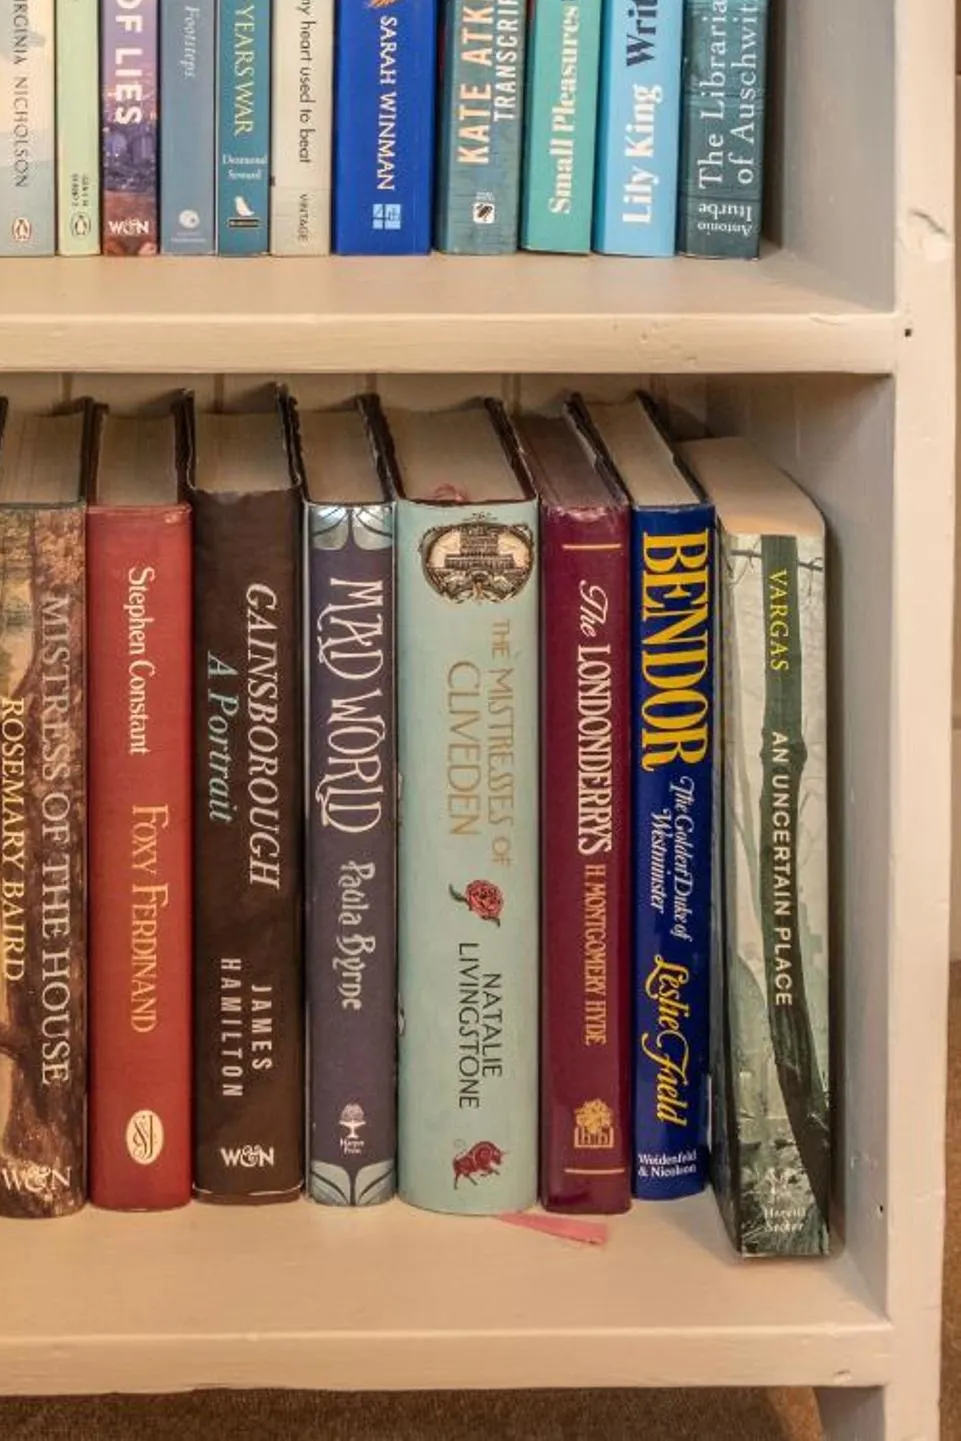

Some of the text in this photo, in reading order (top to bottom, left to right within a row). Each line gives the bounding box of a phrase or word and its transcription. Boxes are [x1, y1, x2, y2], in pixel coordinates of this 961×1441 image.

[114, 45, 144, 125] LIES
[180, 4, 201, 78] Footsteps
[233, 4, 257, 77] YEARS
[299, 20, 317, 62] heart
[299, 66, 317, 104] used
[549, 4, 580, 133] Pleasures
[11, 76, 30, 188] NICHOLSON
[233, 83, 256, 136] WAR
[298, 128, 316, 164] beat
[299, 107, 316, 124] to
[376, 15, 398, 191] SARAH WINMAN
[457, 82, 492, 164] KATE
[620, 83, 662, 224] Lily King
[548, 140, 574, 215] Small
[696, 133, 723, 189] The
[697, 204, 753, 222] Iturbe
[729, 154, 759, 185] of
[297, 193, 310, 242] VINTAGE
[696, 222, 753, 238] Antonio
[128, 566, 155, 754] Stephen Constant
[640, 527, 710, 773] BENDOR
[768, 568, 790, 672] VARGAS
[206, 650, 238, 823] A Portrait
[244, 582, 282, 891] GAINSBOROUGH
[315, 576, 385, 834] MAD WORLD
[446, 660, 481, 838] CLIVEDEN
[487, 618, 514, 868] THE MISTRESSES OF
[577, 578, 613, 856] The LONDONDERRYS
[0, 696, 26, 981] ROSEMARY BAIRD
[39, 593, 70, 1086] MISTRESS OF THE HOUSE
[770, 730, 795, 1007] AN UNCERTAIN PLACE
[334, 859, 377, 1011] Paula Byrne
[218, 957, 244, 1098] HAMILTON
[250, 983, 274, 1072] JAMES
[457, 941, 482, 1109] LIVINGSTONE
[481, 972, 504, 1079] NATALIE
[642, 953, 690, 1124] Leslie Field
[0, 1165, 72, 1193] W&N
[220, 1144, 275, 1169] W&N
